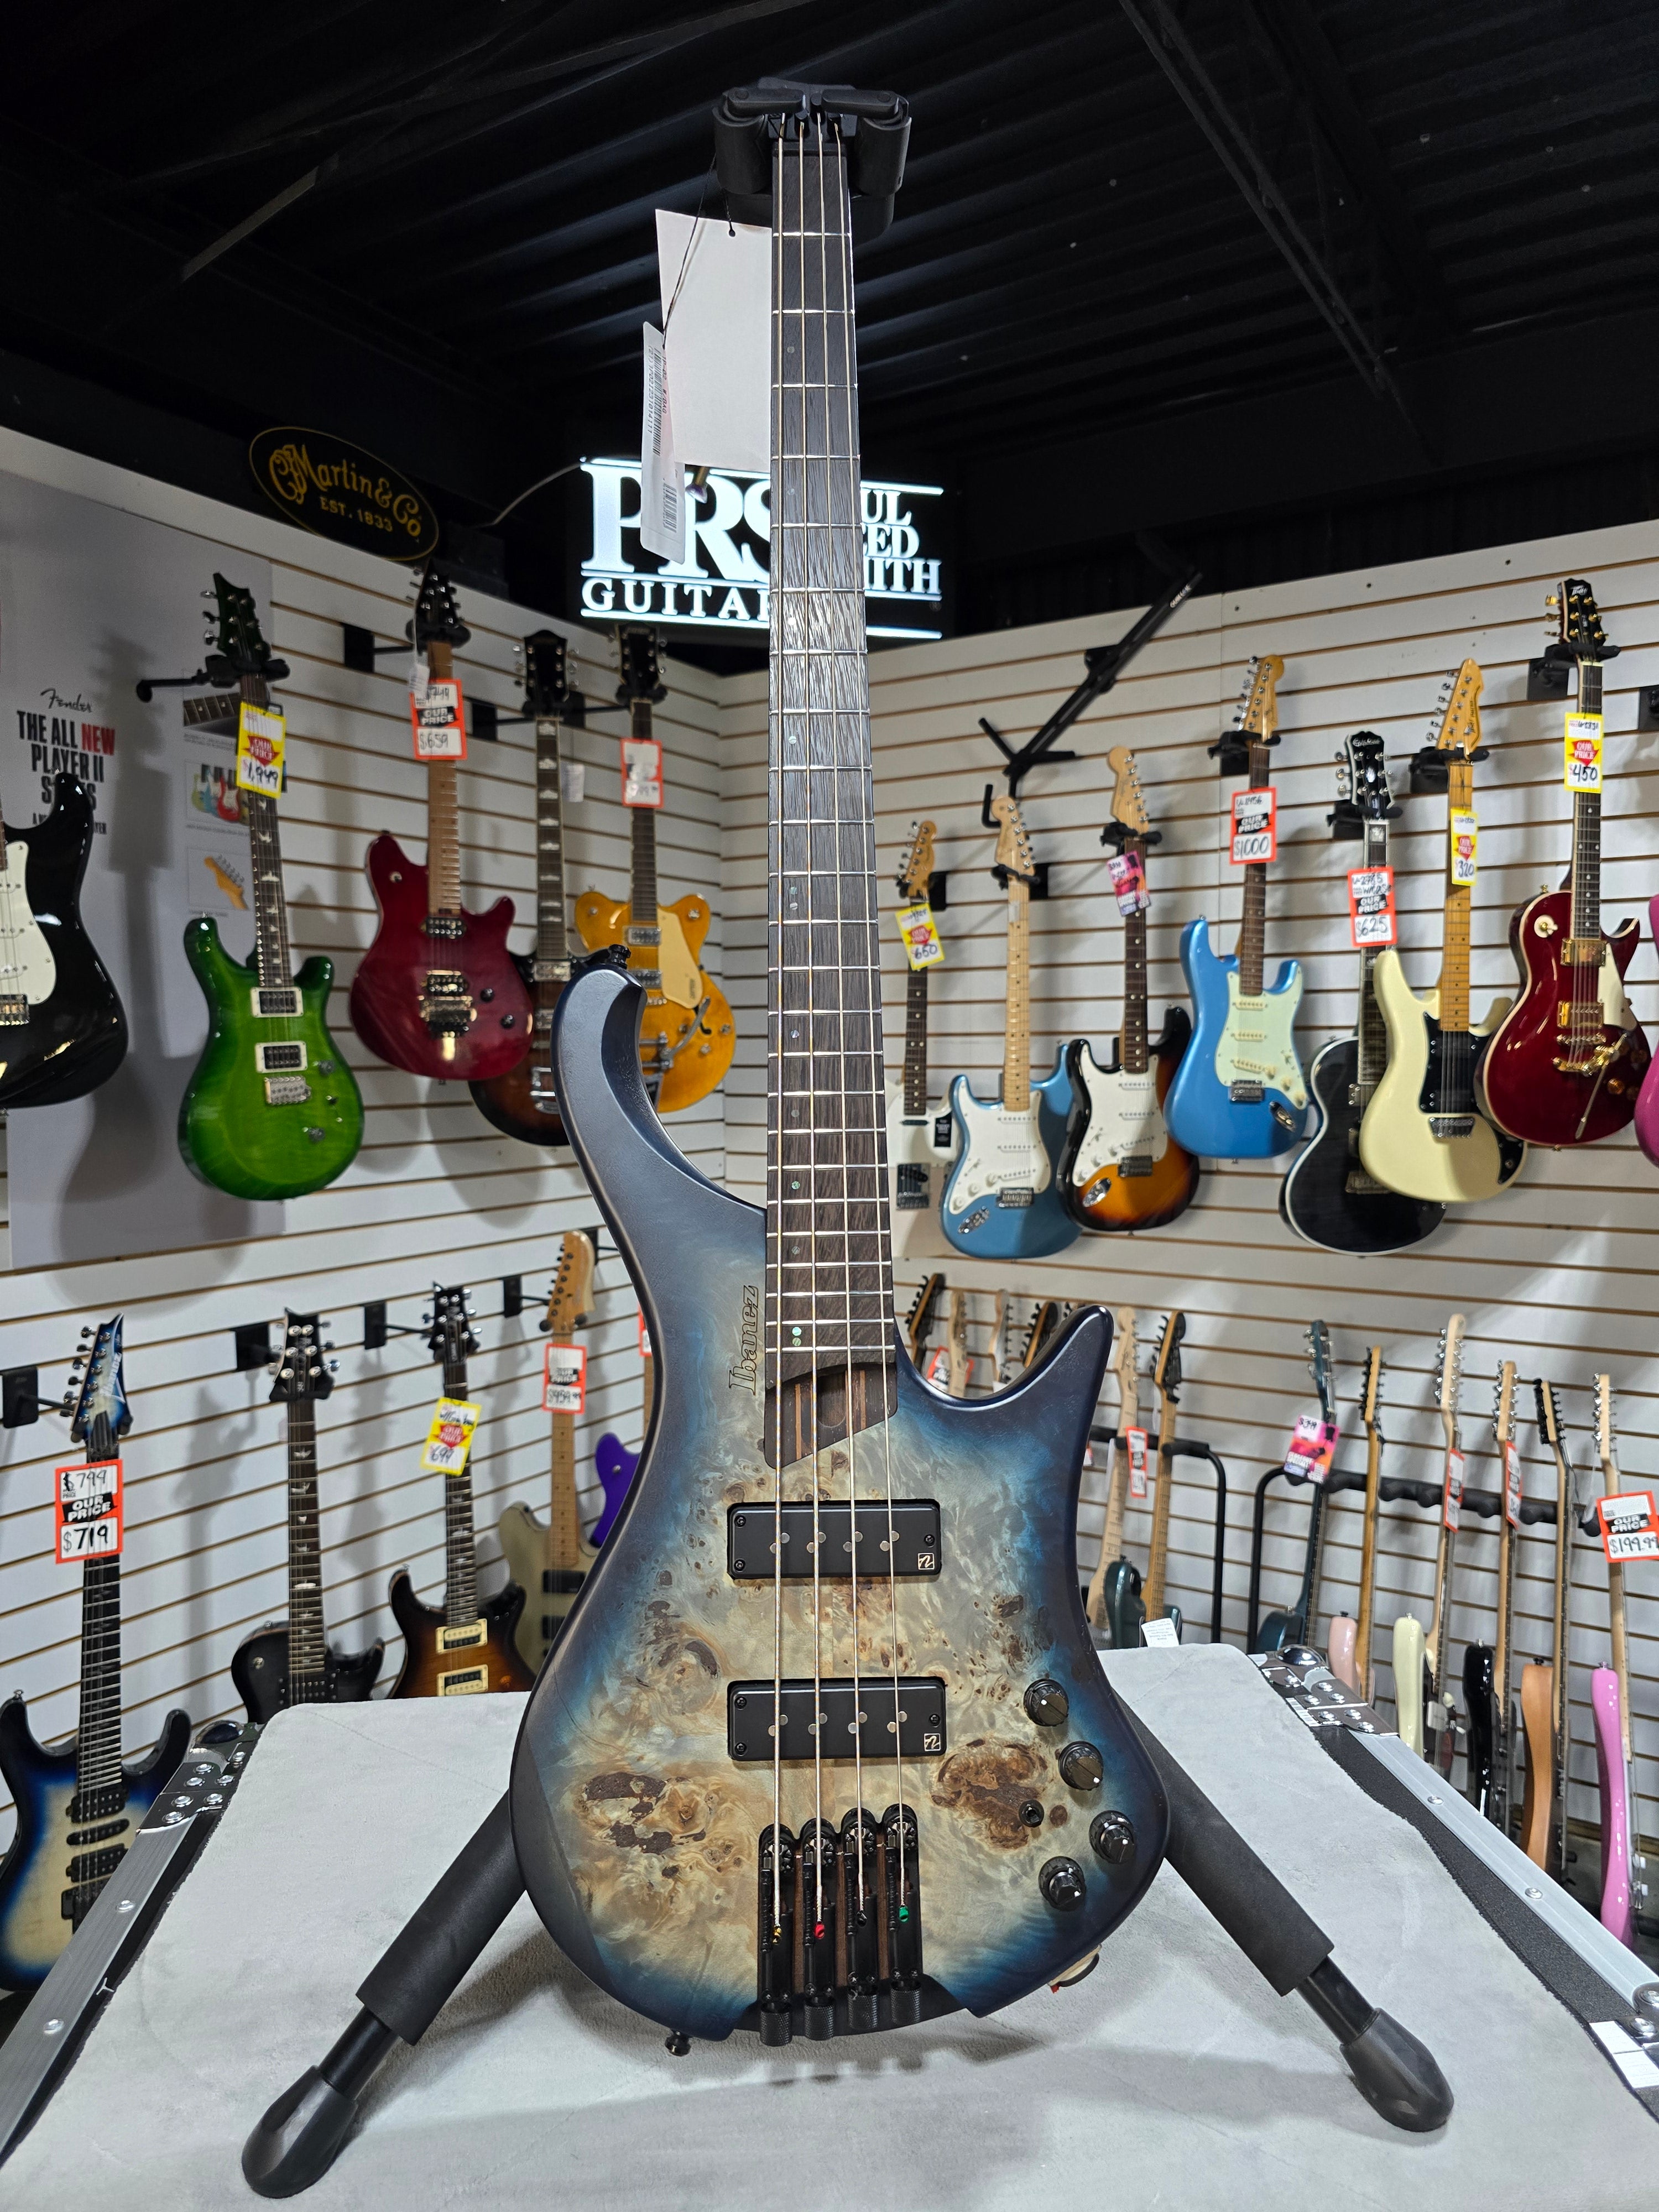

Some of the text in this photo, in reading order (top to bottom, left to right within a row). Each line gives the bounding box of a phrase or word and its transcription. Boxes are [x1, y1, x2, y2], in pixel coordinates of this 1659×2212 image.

[320, 496, 393, 533] EST. 1833
[860, 488, 912, 526] UL
[861, 522, 920, 559] ED
[863, 556, 942, 594] ITH
[582, 577, 770, 622] GUITA
[40, 687, 92, 713] Fender
[421, 714, 455, 726] PRICE
[424, 708, 448, 717] OUR
[17, 710, 115, 756] THE ALL NEW
[1574, 750, 1594, 759] PRICE
[1577, 742, 1592, 751] OUR
[32, 743, 90, 780] PLAYER
[1238, 819, 1268, 834] PRICE
[1241, 815, 1263, 826] OUR
[1234, 836, 1269, 858] $1000
[1358, 900, 1386, 914] PRICE
[1360, 896, 1381, 906] OUR
[1356, 916, 1387, 937] $625
[728, 1285, 759, 1396] Ibanez
[67, 1501, 111, 1522] PRICE
[72, 1495, 104, 1511] OUR
[1611, 1519, 1648, 1533] PRICE
[1614, 1515, 1641, 1525] OUR
[63, 1524, 108, 1552] $719
